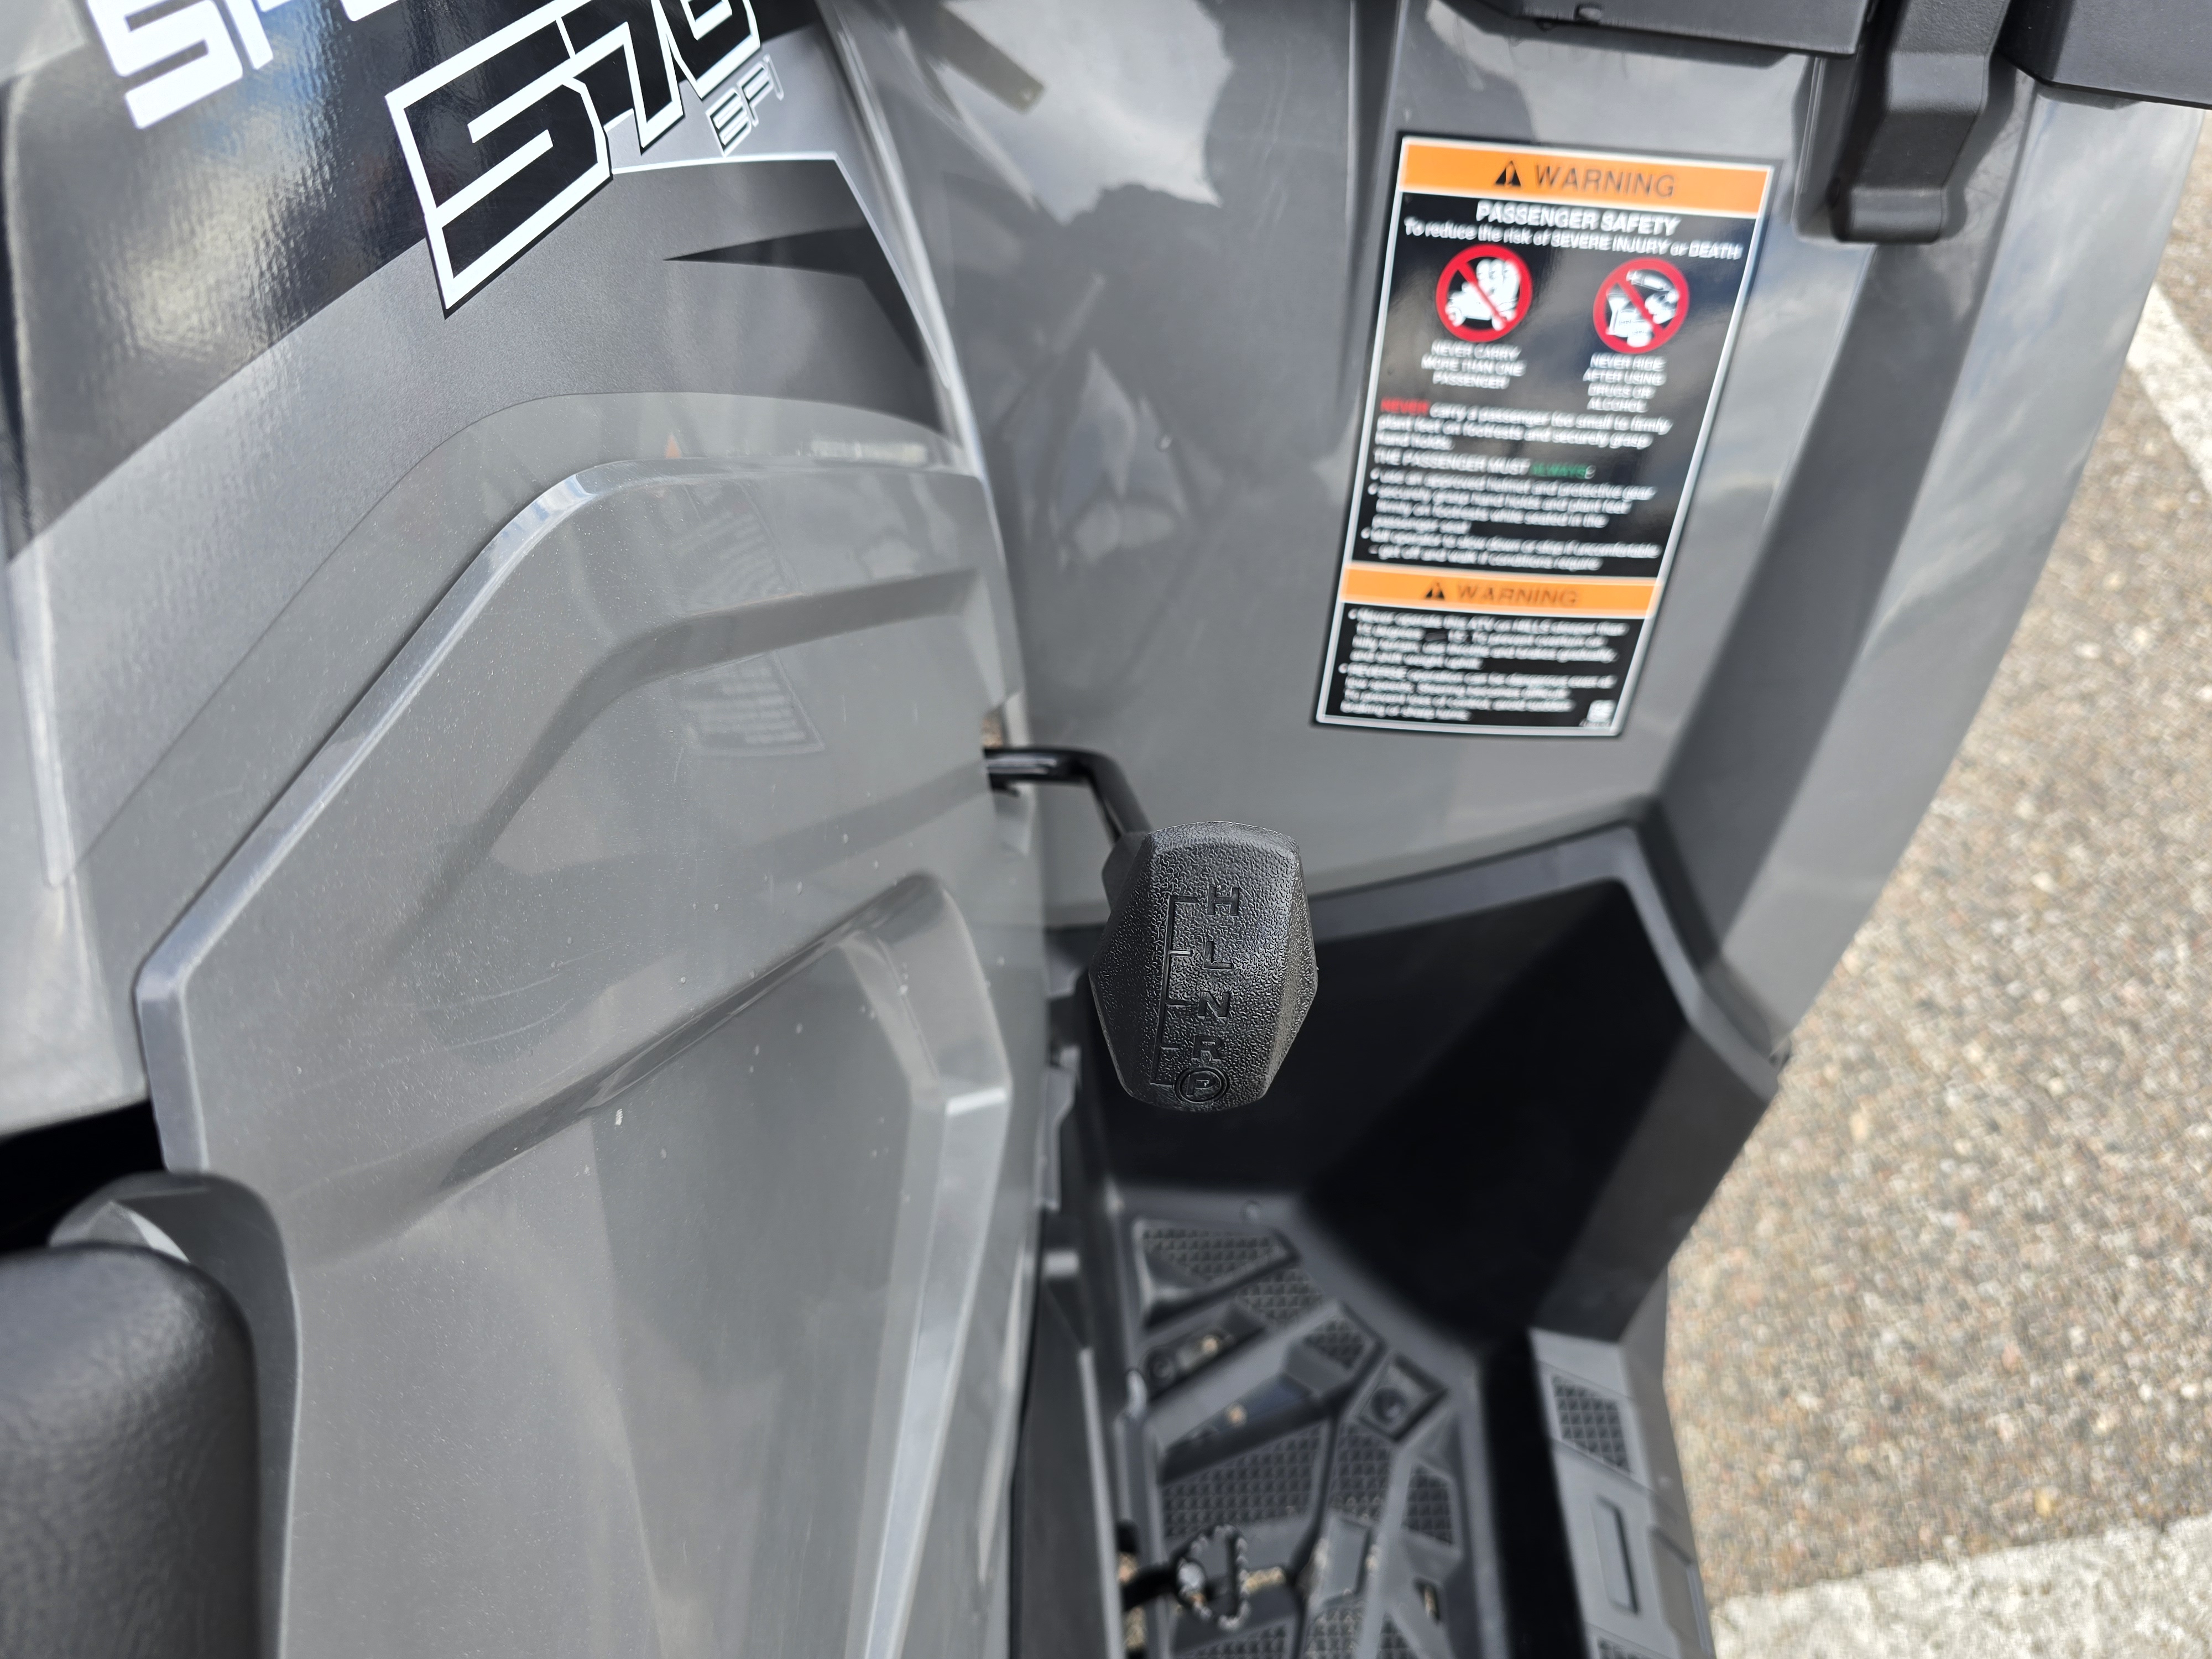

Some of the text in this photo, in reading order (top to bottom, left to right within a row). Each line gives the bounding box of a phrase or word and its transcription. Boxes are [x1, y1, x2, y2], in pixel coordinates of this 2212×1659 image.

[705, 54, 784, 158] EFI
[1534, 164, 1675, 198] WARNING
[1476, 200, 1682, 236] PASSENGER SAFETY
[1404, 216, 1743, 260] To reduce the risk of SEVERE INJURY or DEATH
[1431, 339, 1522, 361] NEVER CARRY
[1590, 352, 1667, 371] NEVER RIDE
[1421, 353, 1527, 376] MORE THAN ONE
[1583, 368, 1667, 385] AFTER USING
[1433, 371, 1510, 389] PASSENGER
[1588, 383, 1656, 399] DRUGS OR
[1380, 398, 1673, 435] NEVER carry a passenger too small to firmly
[1524, 425, 1552, 442] and
[1552, 428, 1610, 448] securely
[1609, 431, 1653, 450] grasp
[1373, 446, 1402, 466] THE
[1402, 448, 1488, 472] PASSENGER
[1487, 456, 1531, 475] MUST
[1456, 582, 1579, 608] WARNING
[1206, 885, 1241, 916] H
[1203, 940, 1234, 971] L
[1197, 990, 1232, 1019] N
[1192, 1035, 1223, 1063] R
